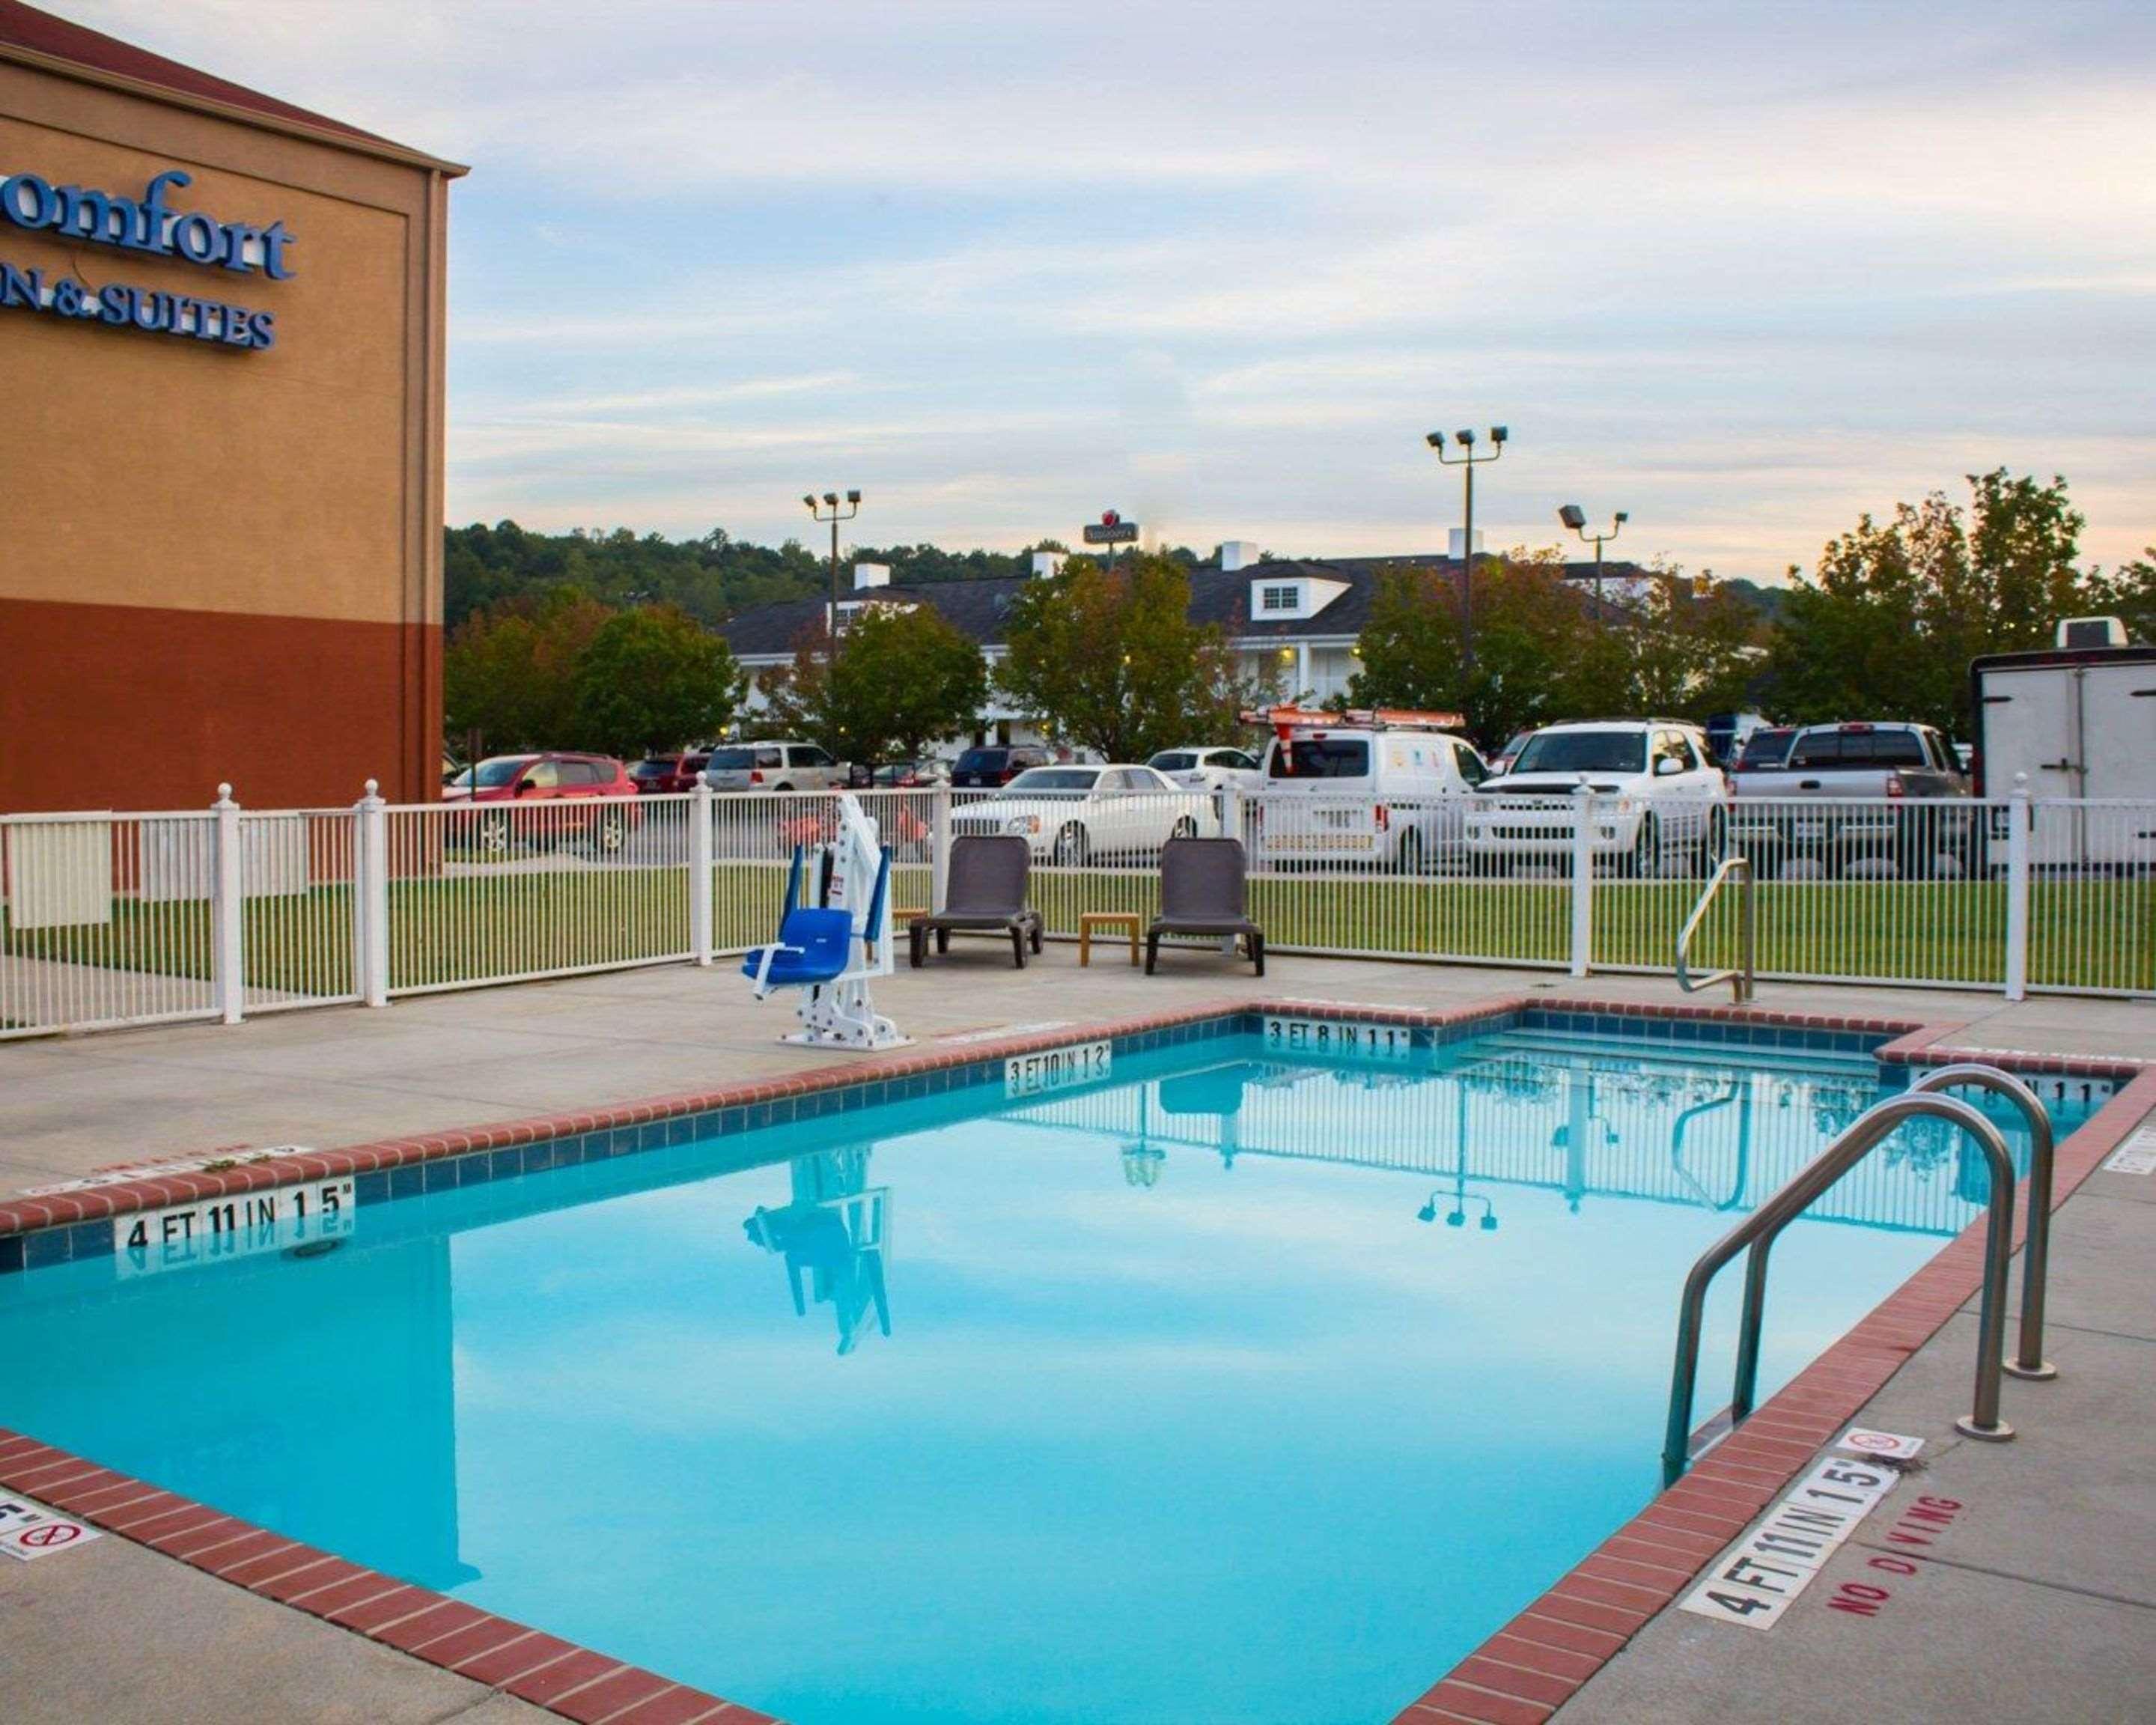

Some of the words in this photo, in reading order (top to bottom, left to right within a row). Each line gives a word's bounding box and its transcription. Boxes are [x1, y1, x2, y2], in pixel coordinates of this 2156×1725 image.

[53, 279, 91, 318] &
[98, 284, 275, 350] SUITES
[1270, 1020, 1282, 1037] 3
[1289, 1023, 1309, 1038] FT
[1339, 1026, 1358, 1043] IN
[1026, 1056, 1041, 1077] FT
[1062, 1050, 1076, 1069] IN
[127, 1219, 148, 1248] 4
[162, 1211, 196, 1244] FT
[208, 1203, 235, 1233] 11
[246, 1196, 275, 1228] IN
[1775, 1506, 1846, 1536] IN
[1752, 1532, 1824, 1559] 11
[1826, 1583, 1891, 1617] NO
[1867, 1496, 1964, 1575] DIVING
[1723, 1556, 1799, 1593] FT
[1705, 1590, 1772, 1616] 4
